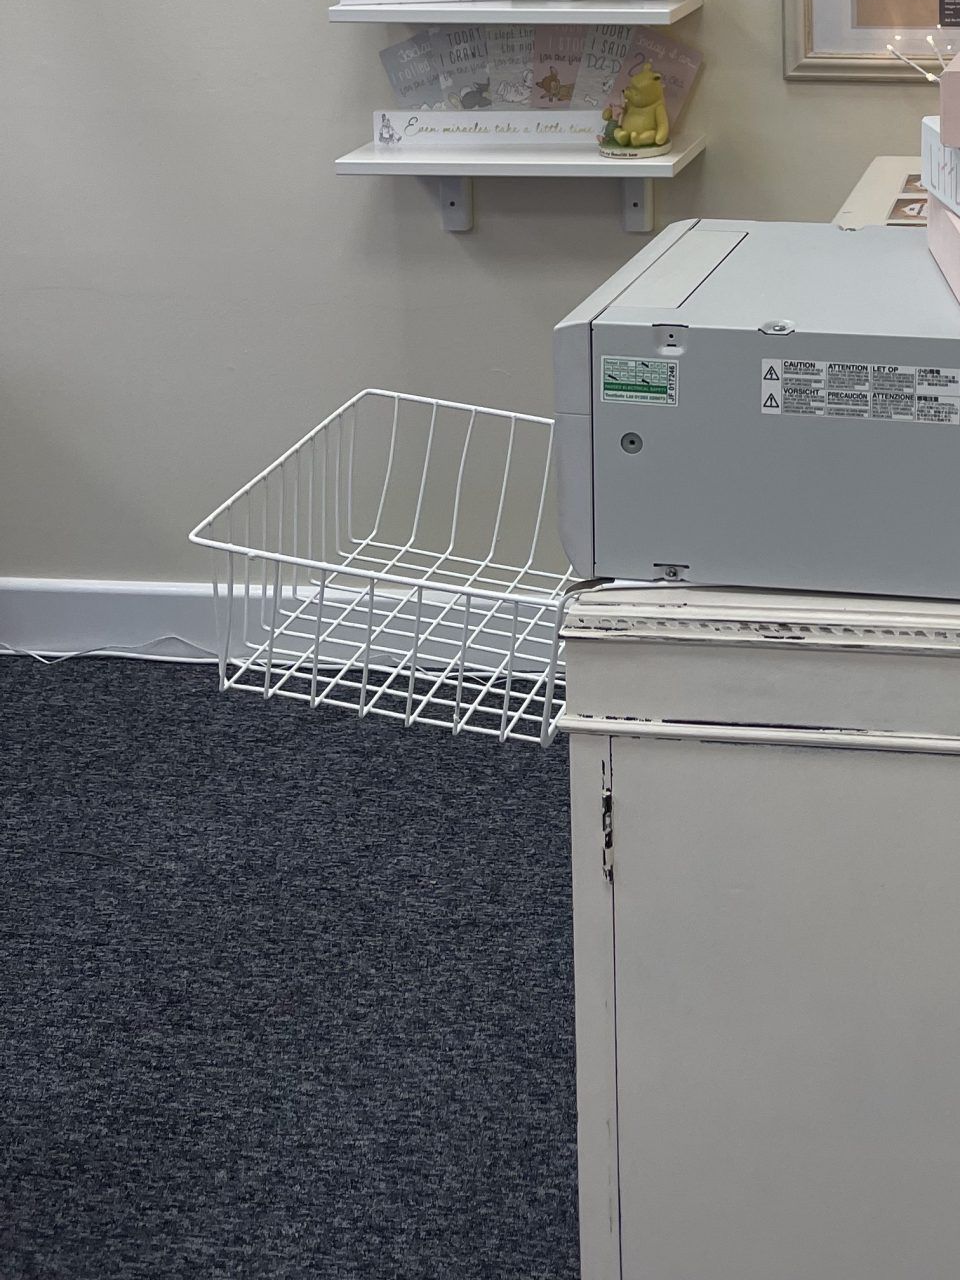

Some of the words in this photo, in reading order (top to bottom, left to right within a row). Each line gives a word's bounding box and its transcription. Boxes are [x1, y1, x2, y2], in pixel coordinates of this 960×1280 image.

[446, 28, 482, 46] TODAY
[601, 39, 628, 58] SAID
[443, 121, 489, 133] miracles
[494, 122, 519, 133] take
[536, 122, 564, 133] little
[783, 361, 816, 369] CAUTION
[828, 363, 868, 371] ATTENTION
[783, 388, 820, 396] VORSICHT
[872, 392, 914, 400] ATTENZIONE
